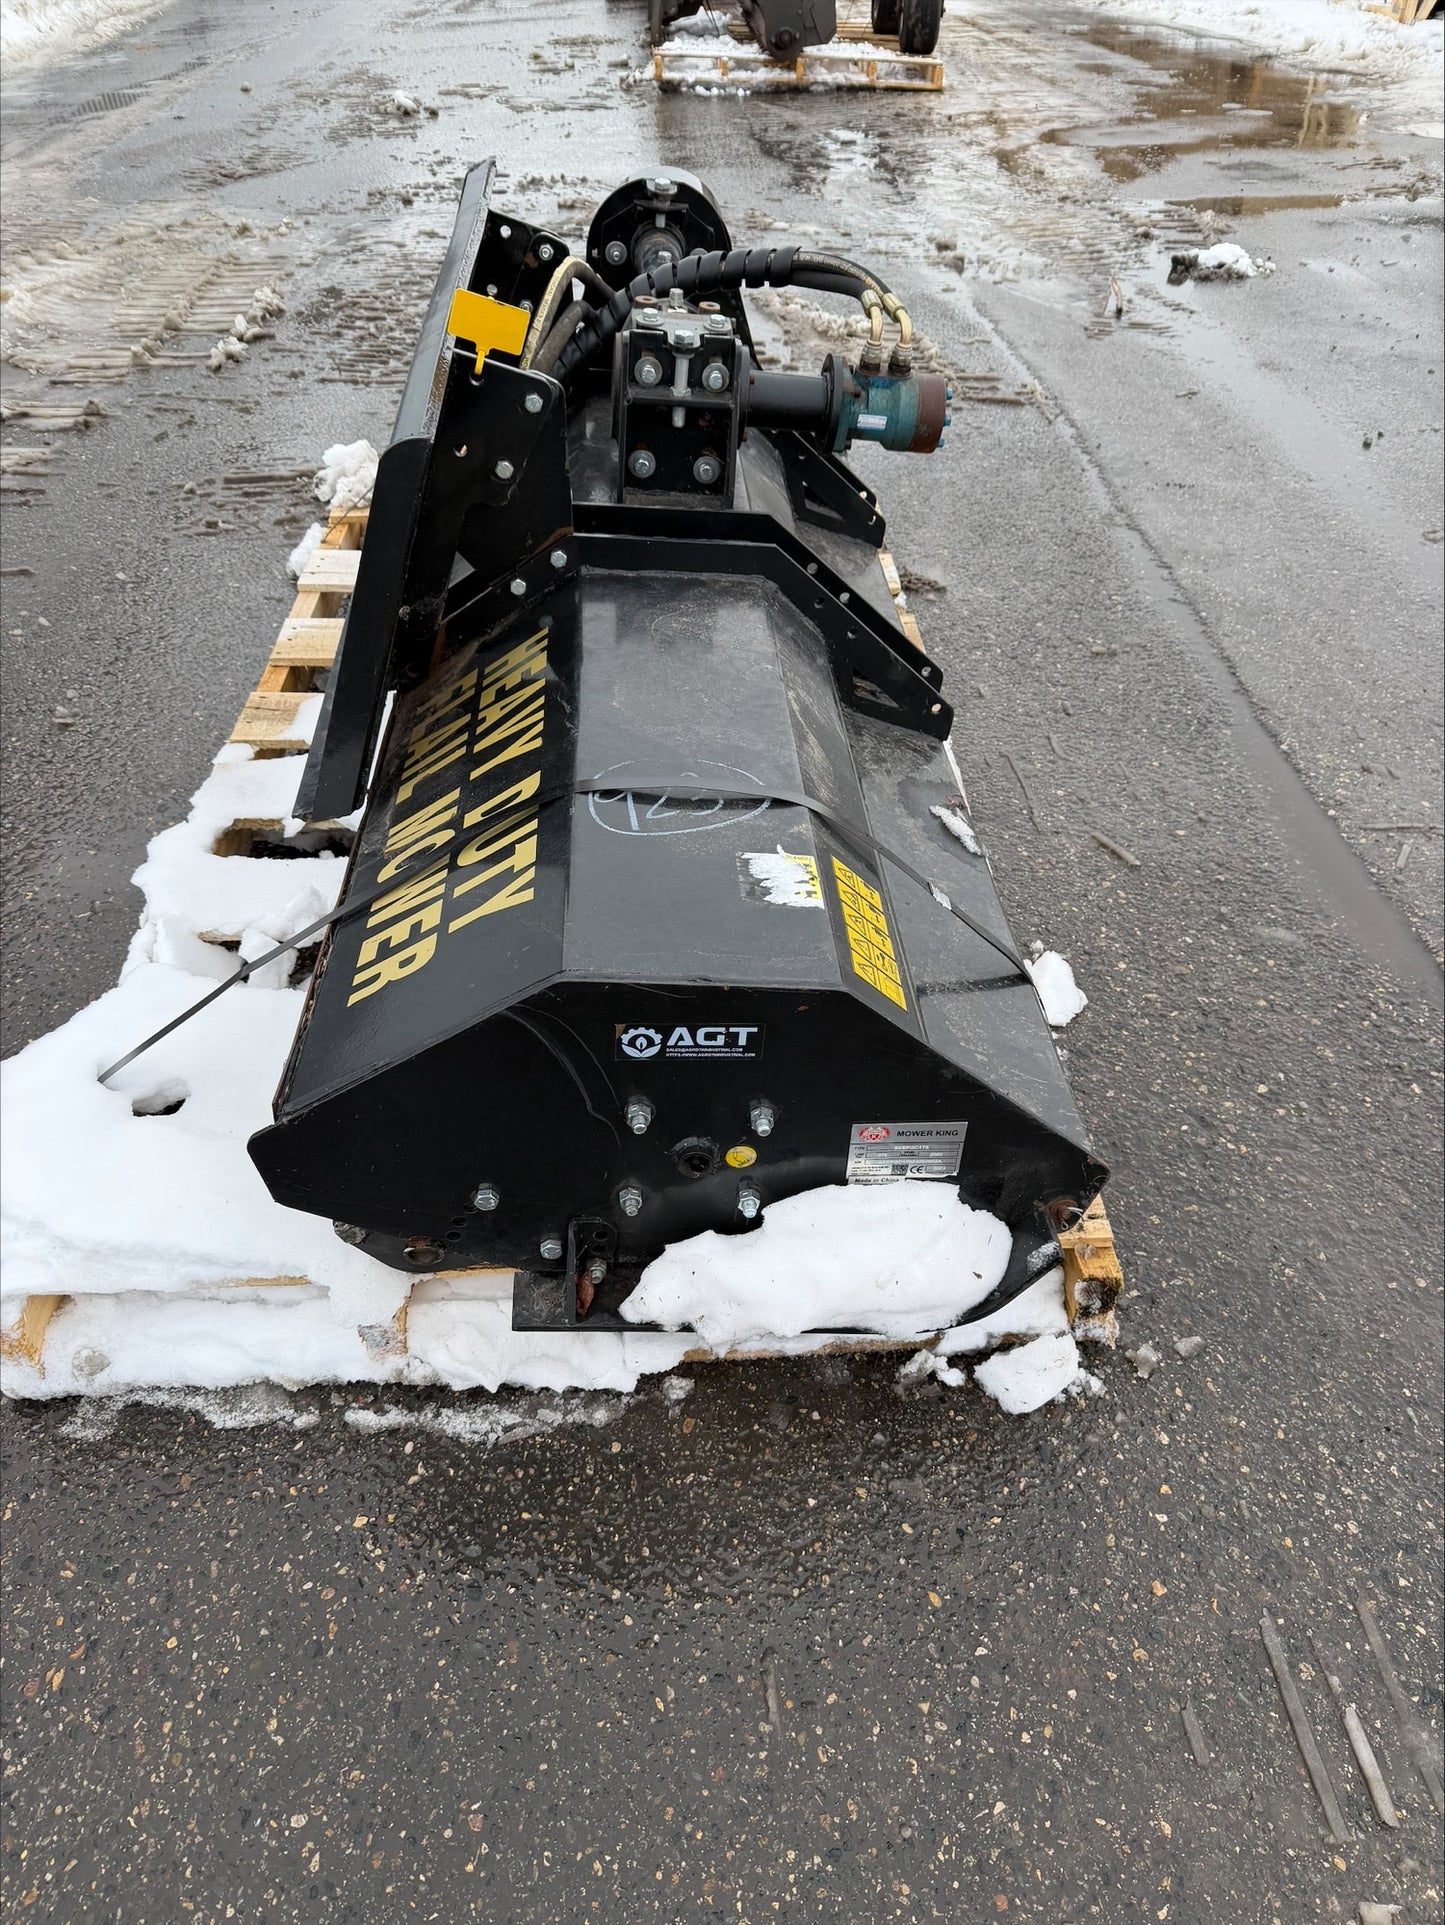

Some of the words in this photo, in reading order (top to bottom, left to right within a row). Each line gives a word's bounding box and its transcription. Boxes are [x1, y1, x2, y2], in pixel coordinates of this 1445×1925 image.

[396, 668, 479, 805] FLAIL
[470, 626, 549, 781] HEAVY
[346, 786, 461, 1008] MOWER
[449, 770, 541, 934] DUTY
[666, 1027, 758, 1046] AGT
[910, 1166, 924, 1174] CE
[935, 1129, 959, 1137] KING
